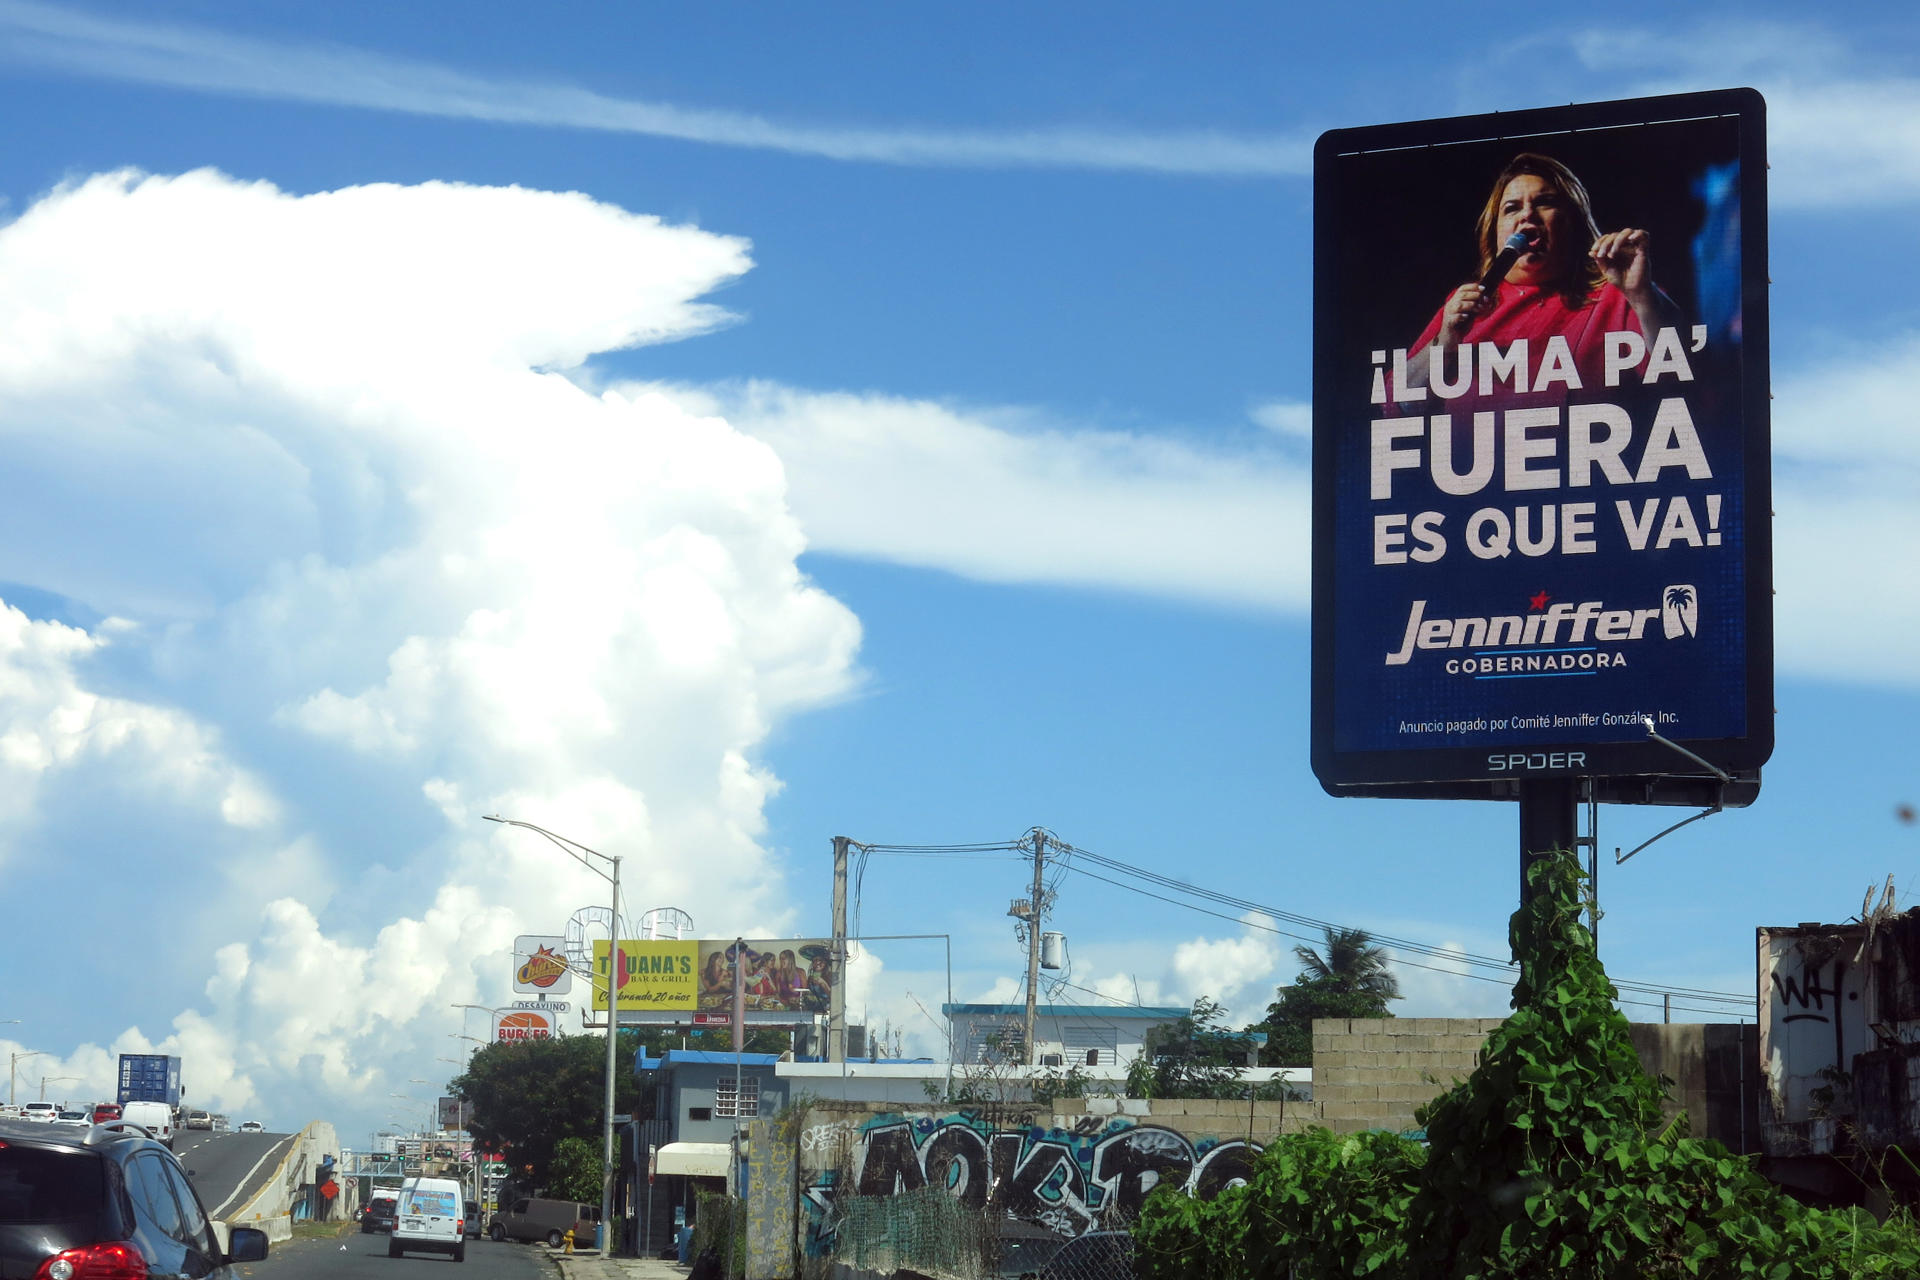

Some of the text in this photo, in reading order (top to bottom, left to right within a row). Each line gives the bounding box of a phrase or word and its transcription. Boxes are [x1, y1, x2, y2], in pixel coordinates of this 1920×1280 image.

[1371, 325, 1707, 403] ¡LUMA PA'
[1371, 397, 1713, 500] FUERA
[1374, 494, 1722, 565] ES QUE VA!
[1385, 598, 1661, 665] Jenniffer
[1445, 652, 1627, 675] GOBERNADORA
[1399, 720, 1444, 733] Anuncio
[1446, 717, 1487, 734] pagado
[1490, 718, 1508, 732] por
[1511, 714, 1550, 729] Comité
[1553, 713, 1599, 727] Jenniffer
[1659, 710, 1679, 723] Inc.
[598, 990, 692, 1002] Cebrando 20 años
[631, 975, 690, 983] BAR & GRILL
